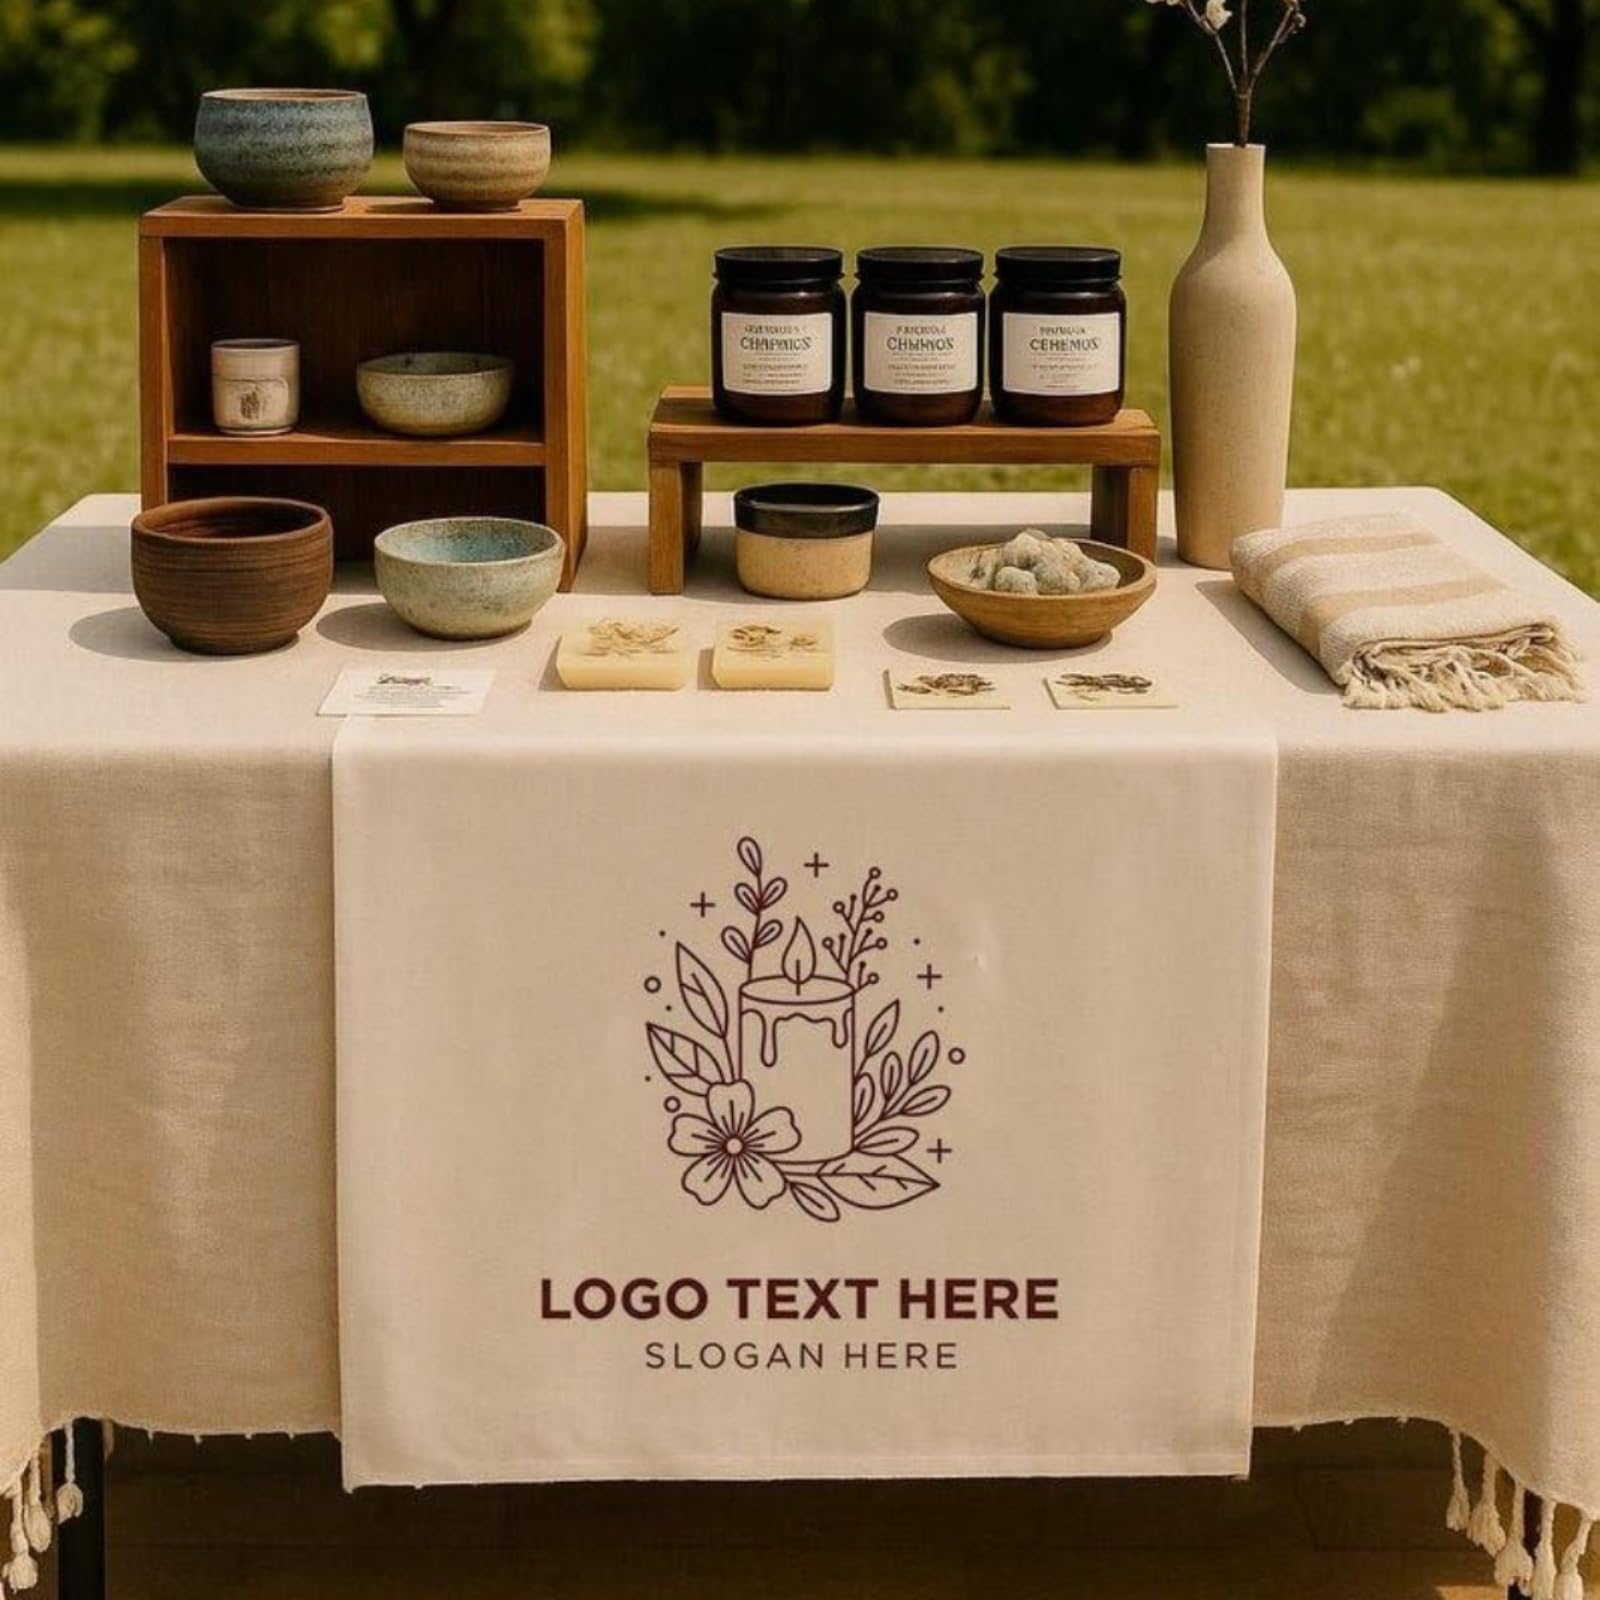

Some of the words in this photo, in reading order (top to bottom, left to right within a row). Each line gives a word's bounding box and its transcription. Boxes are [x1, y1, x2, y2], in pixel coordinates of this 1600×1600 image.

[541, 1277, 709, 1321] LOGO
[726, 1277, 879, 1320] TEXT
[900, 1277, 1059, 1320] HERE
[645, 1341, 823, 1370] SLOGAN
[845, 1341, 957, 1370] HERE
